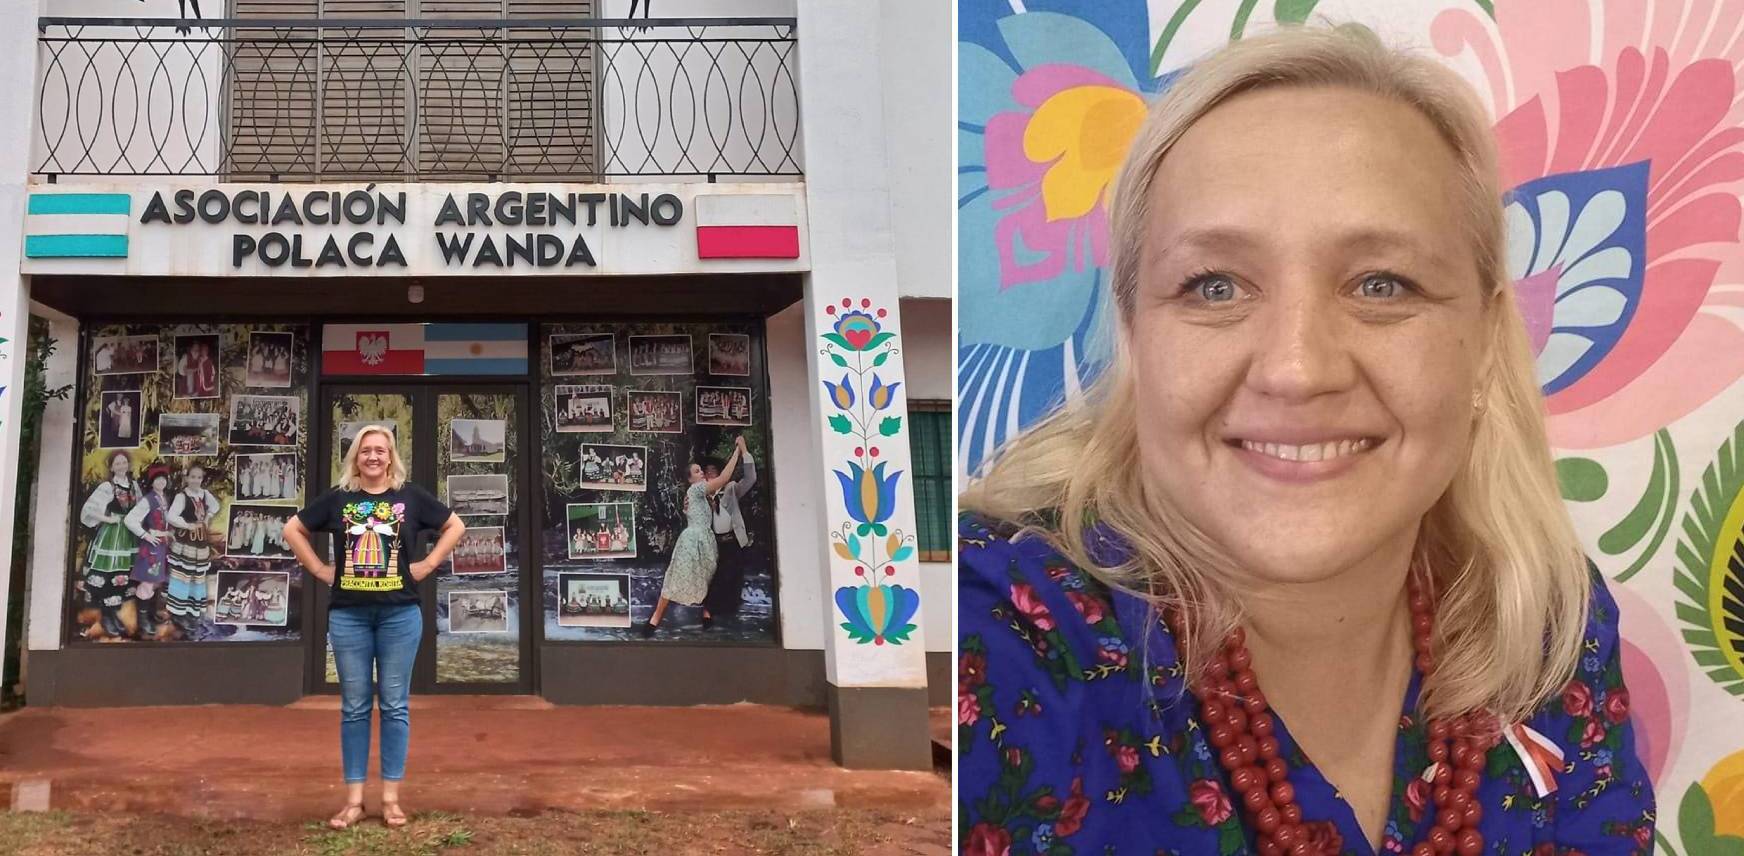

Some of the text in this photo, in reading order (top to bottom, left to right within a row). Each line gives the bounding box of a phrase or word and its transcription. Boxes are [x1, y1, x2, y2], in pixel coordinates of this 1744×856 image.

[139, 183, 684, 227] ASOCIACIÓN ARGENTINO
[231, 231, 597, 268] POLACA WANDA
